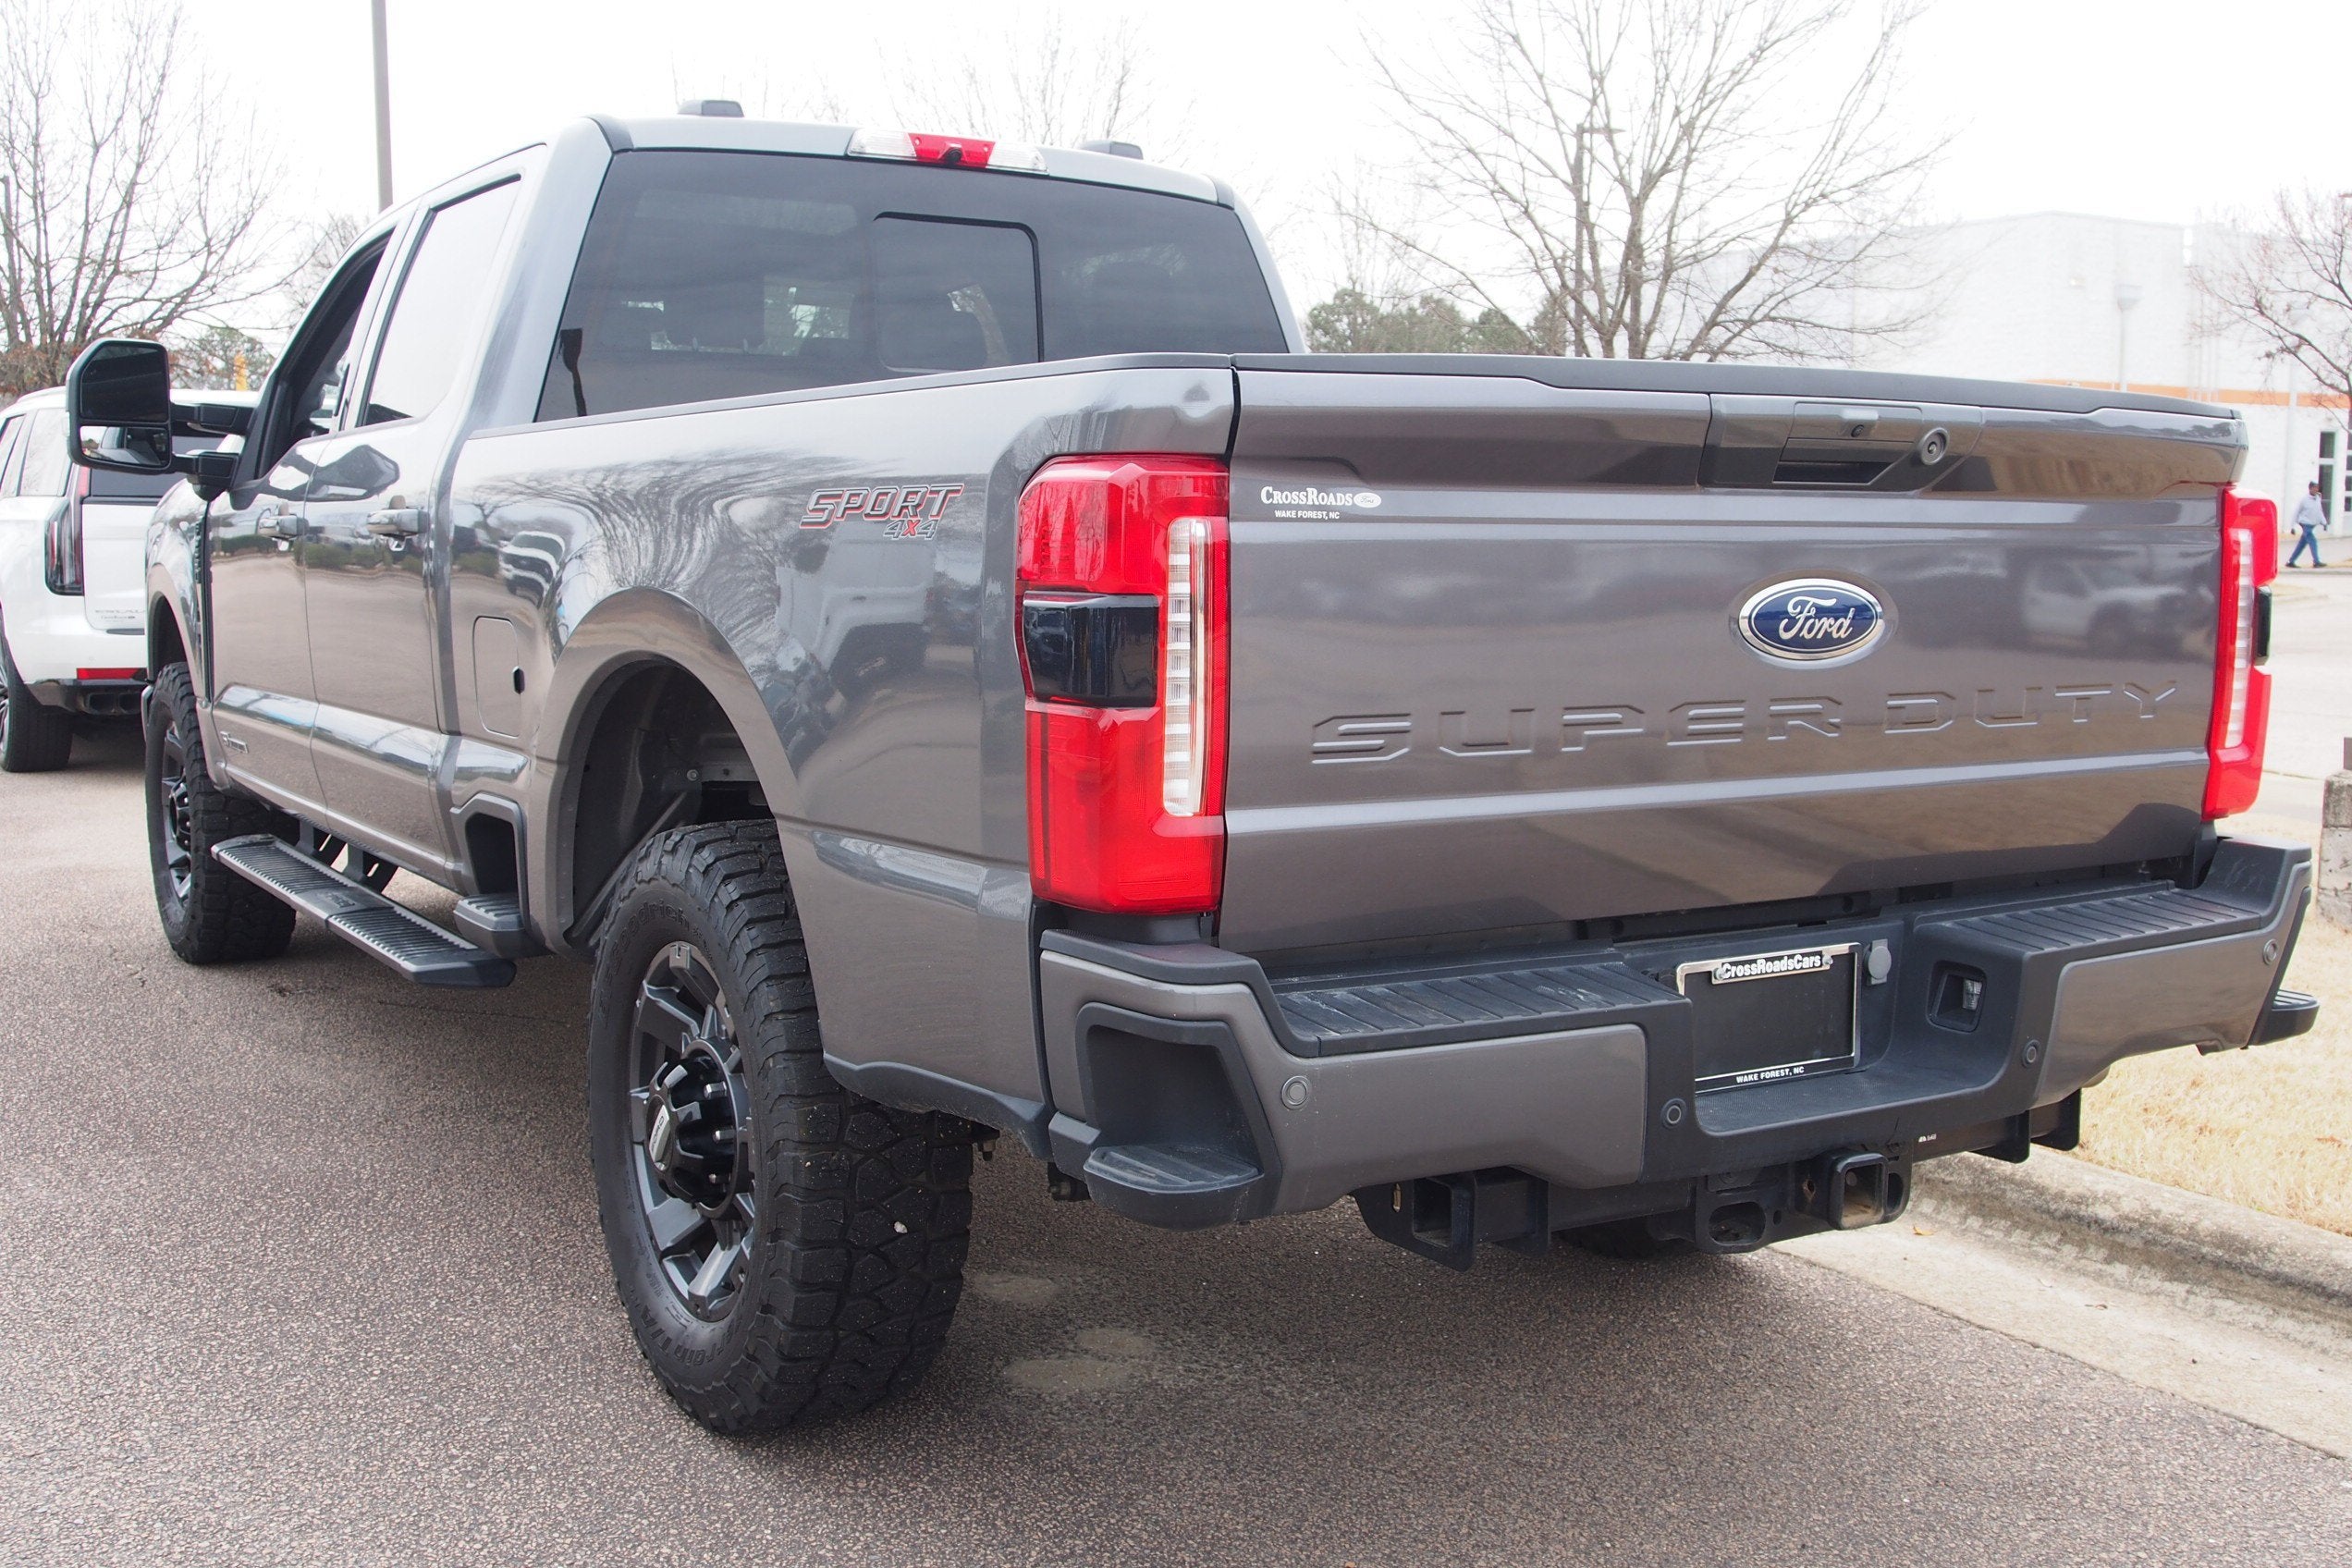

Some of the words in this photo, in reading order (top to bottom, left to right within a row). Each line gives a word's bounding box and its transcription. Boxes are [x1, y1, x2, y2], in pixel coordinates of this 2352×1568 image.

[799, 484, 964, 529] SPORT
[1274, 509, 1296, 518] WAKE
[1298, 510, 1329, 520] FOREST,
[1329, 511, 1341, 520] NC
[1779, 595, 1856, 640] Ford
[1312, 695, 1843, 765] SUPER
[1883, 680, 2177, 735] DUTY
[1722, 954, 1821, 979] CrossRoadsCars
[1736, 1072, 1758, 1084] WAKE
[1760, 1068, 1793, 1080] FOREST,
[1794, 1066, 1805, 1075] NC
